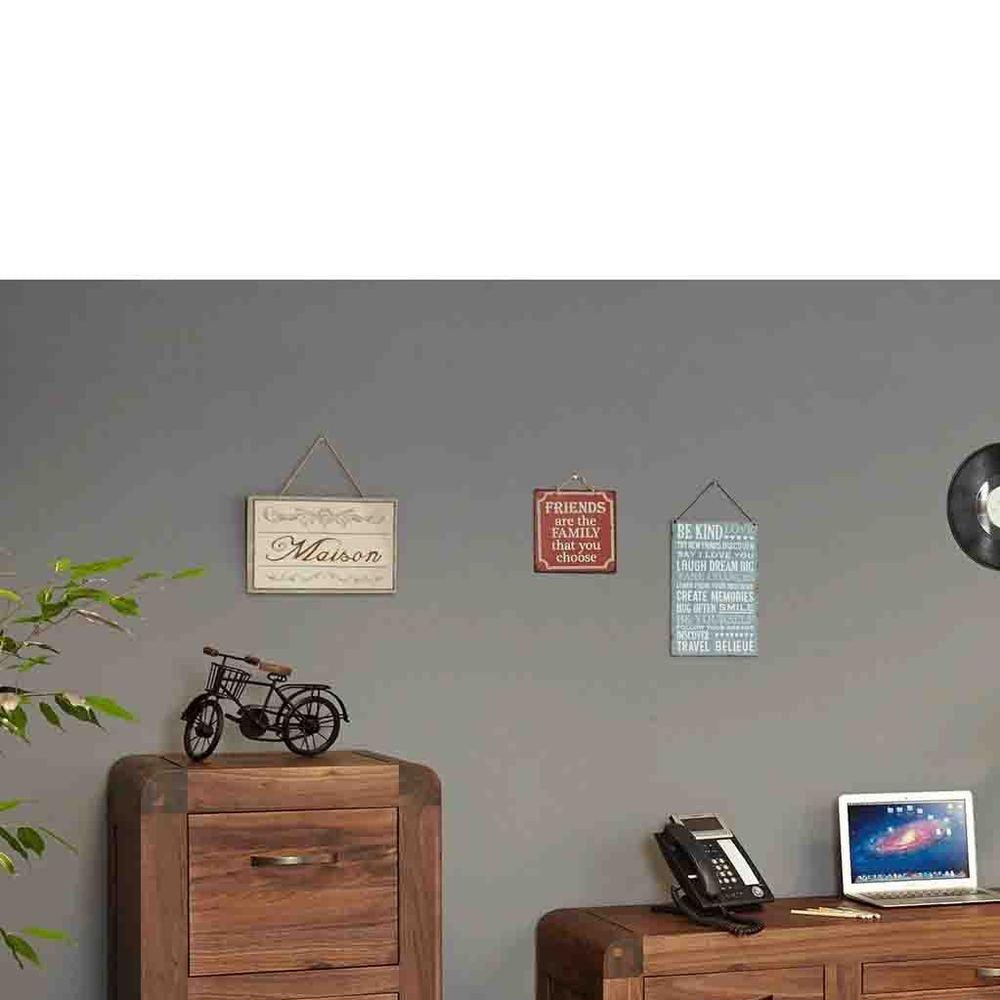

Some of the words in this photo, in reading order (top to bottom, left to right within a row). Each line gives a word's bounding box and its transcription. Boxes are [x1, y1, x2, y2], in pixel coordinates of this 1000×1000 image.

[545, 501, 606, 514] FRIENDS
[555, 516, 574, 526] are
[577, 515, 597, 526] the
[552, 527, 601, 538] FAMILY
[677, 523, 692, 540] BE
[695, 523, 723, 540] KIND
[266, 535, 382, 562] Maison
[551, 540, 575, 550] that
[578, 541, 601, 554] you
[556, 551, 597, 562] choose
[676, 560, 706, 571] LAUGH
[709, 560, 738, 571] DREAM
[676, 590, 707, 602] CREATE
[711, 591, 754, 602] MEMORIES
[719, 603, 752, 611] SMILE
[677, 640, 709, 652] TRAVEL
